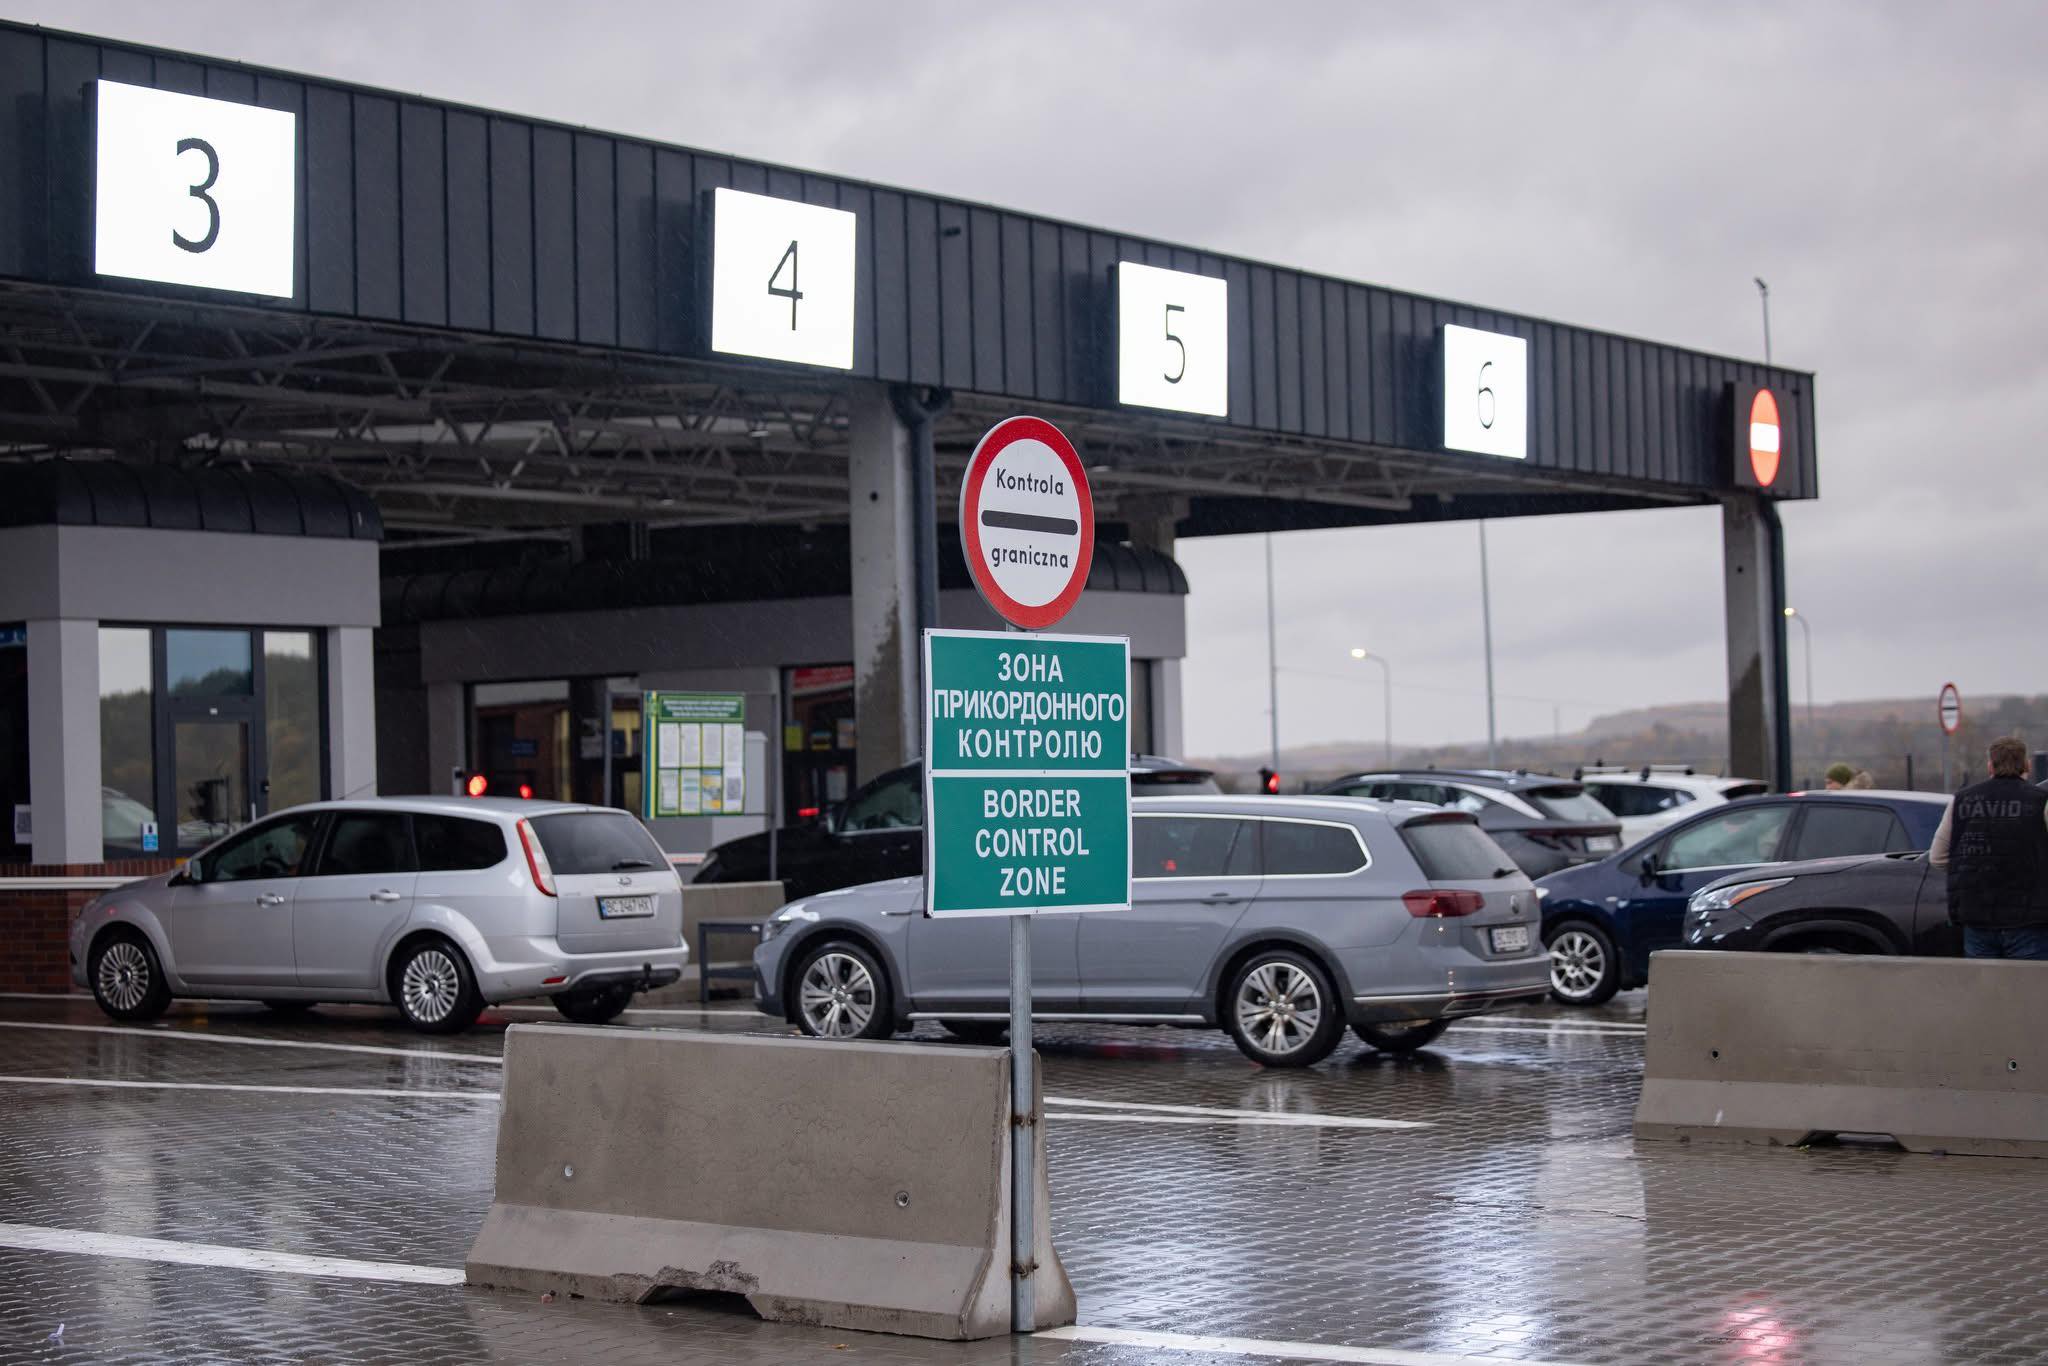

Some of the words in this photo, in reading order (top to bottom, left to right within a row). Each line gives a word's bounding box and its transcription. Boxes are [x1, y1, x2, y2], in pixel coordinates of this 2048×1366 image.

[172, 137, 220, 254] 3
[767, 239, 804, 331] 4
[1163, 303, 1186, 385] 5
[1477, 360, 1496, 430] 6
[995, 467, 1065, 496] Kontrola
[990, 544, 1070, 569] graniczna
[997, 652, 1064, 683] ЗОНА
[933, 689, 1125, 726] ПРИКОРДОННОГО
[958, 728, 1102, 759] КОНТРОЛЮ
[983, 789, 1082, 818] BORDER
[975, 827, 1090, 858] CONTROL
[999, 866, 1066, 897] ZONE
